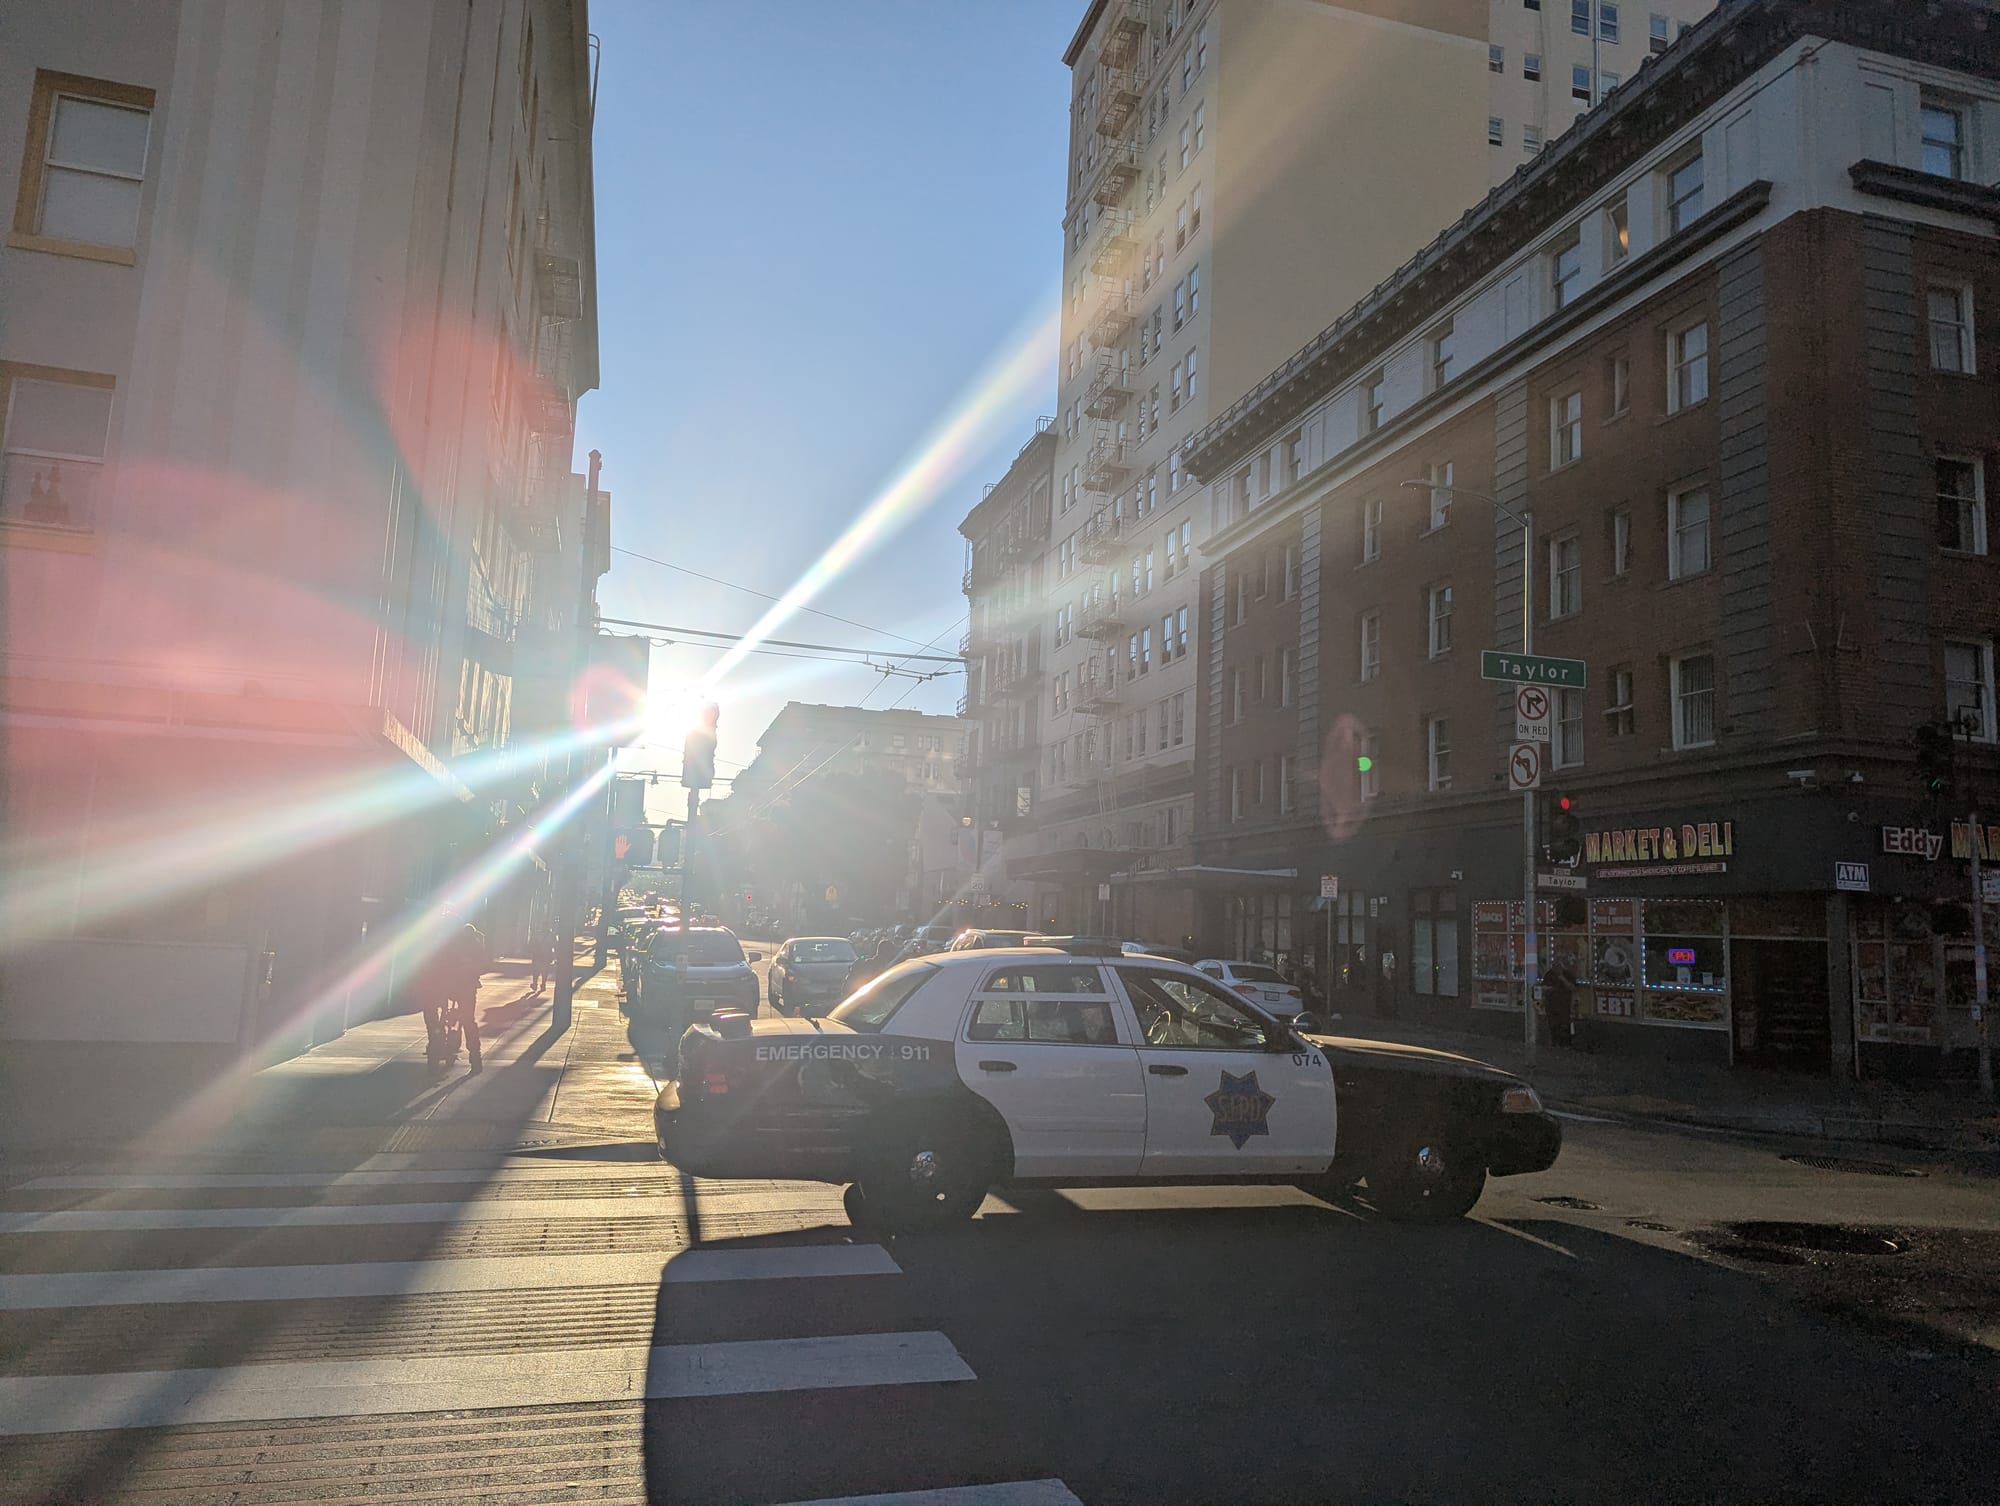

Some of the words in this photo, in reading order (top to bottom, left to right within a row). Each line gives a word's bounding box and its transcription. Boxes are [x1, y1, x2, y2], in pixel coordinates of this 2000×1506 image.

[1499, 659, 1569, 680] Taylor
[1518, 724, 1529, 734] ON
[1532, 726, 1548, 735] RED
[1585, 828, 1660, 863] MARKET
[1662, 826, 1677, 859] &
[1682, 822, 1733, 858] DELI
[1882, 826, 1944, 861] Eddy
[1839, 865, 1866, 881] ATM
[1549, 876, 1576, 887] Taylor
[1597, 996, 1634, 1016] EBT
[756, 1045, 883, 1061] EMERGENCY
[901, 1045, 930, 1061] 911
[1292, 1054, 1322, 1067] 074
